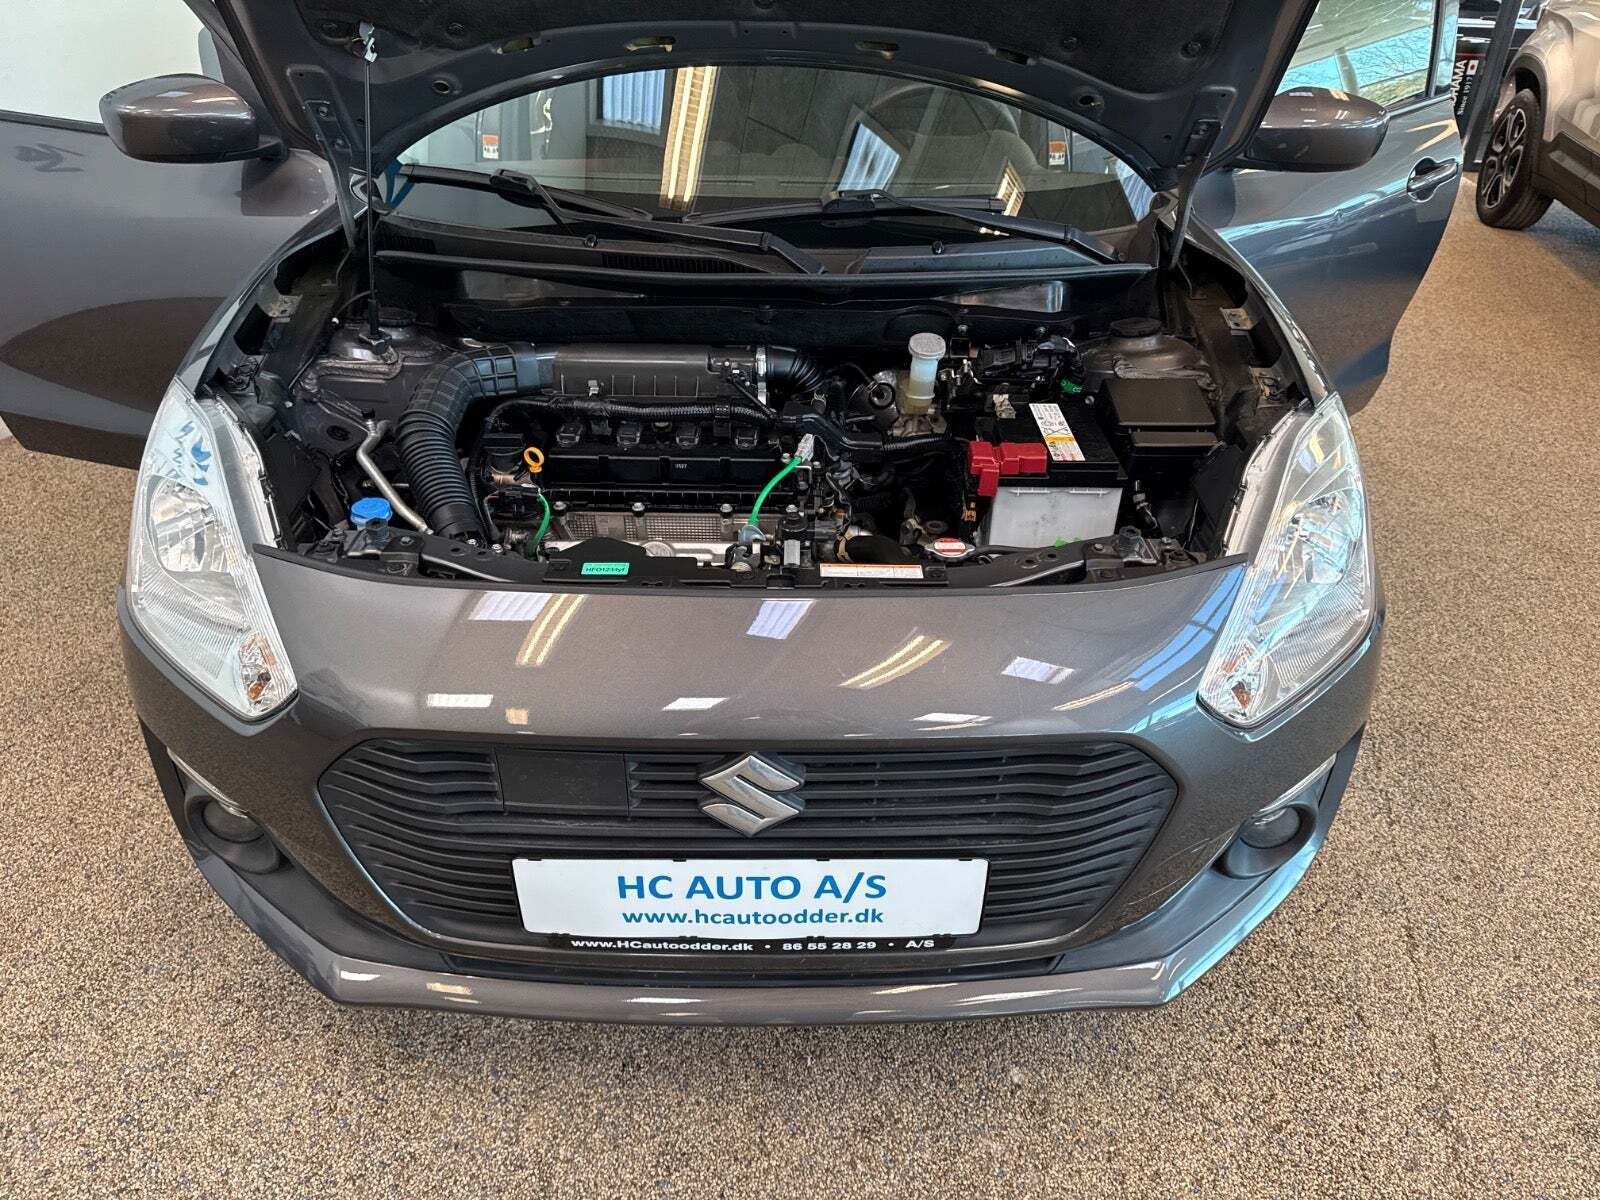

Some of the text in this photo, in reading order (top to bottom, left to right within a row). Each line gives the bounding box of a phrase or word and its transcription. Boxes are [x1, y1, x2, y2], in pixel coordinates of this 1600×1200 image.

[617, 871, 887, 904] HC AUTO A/S
[622, 908, 884, 925] www.hcautoodder.dk
[570, 939, 935, 951] www.HCautoodder.dk 86 55 28 29 A/S
